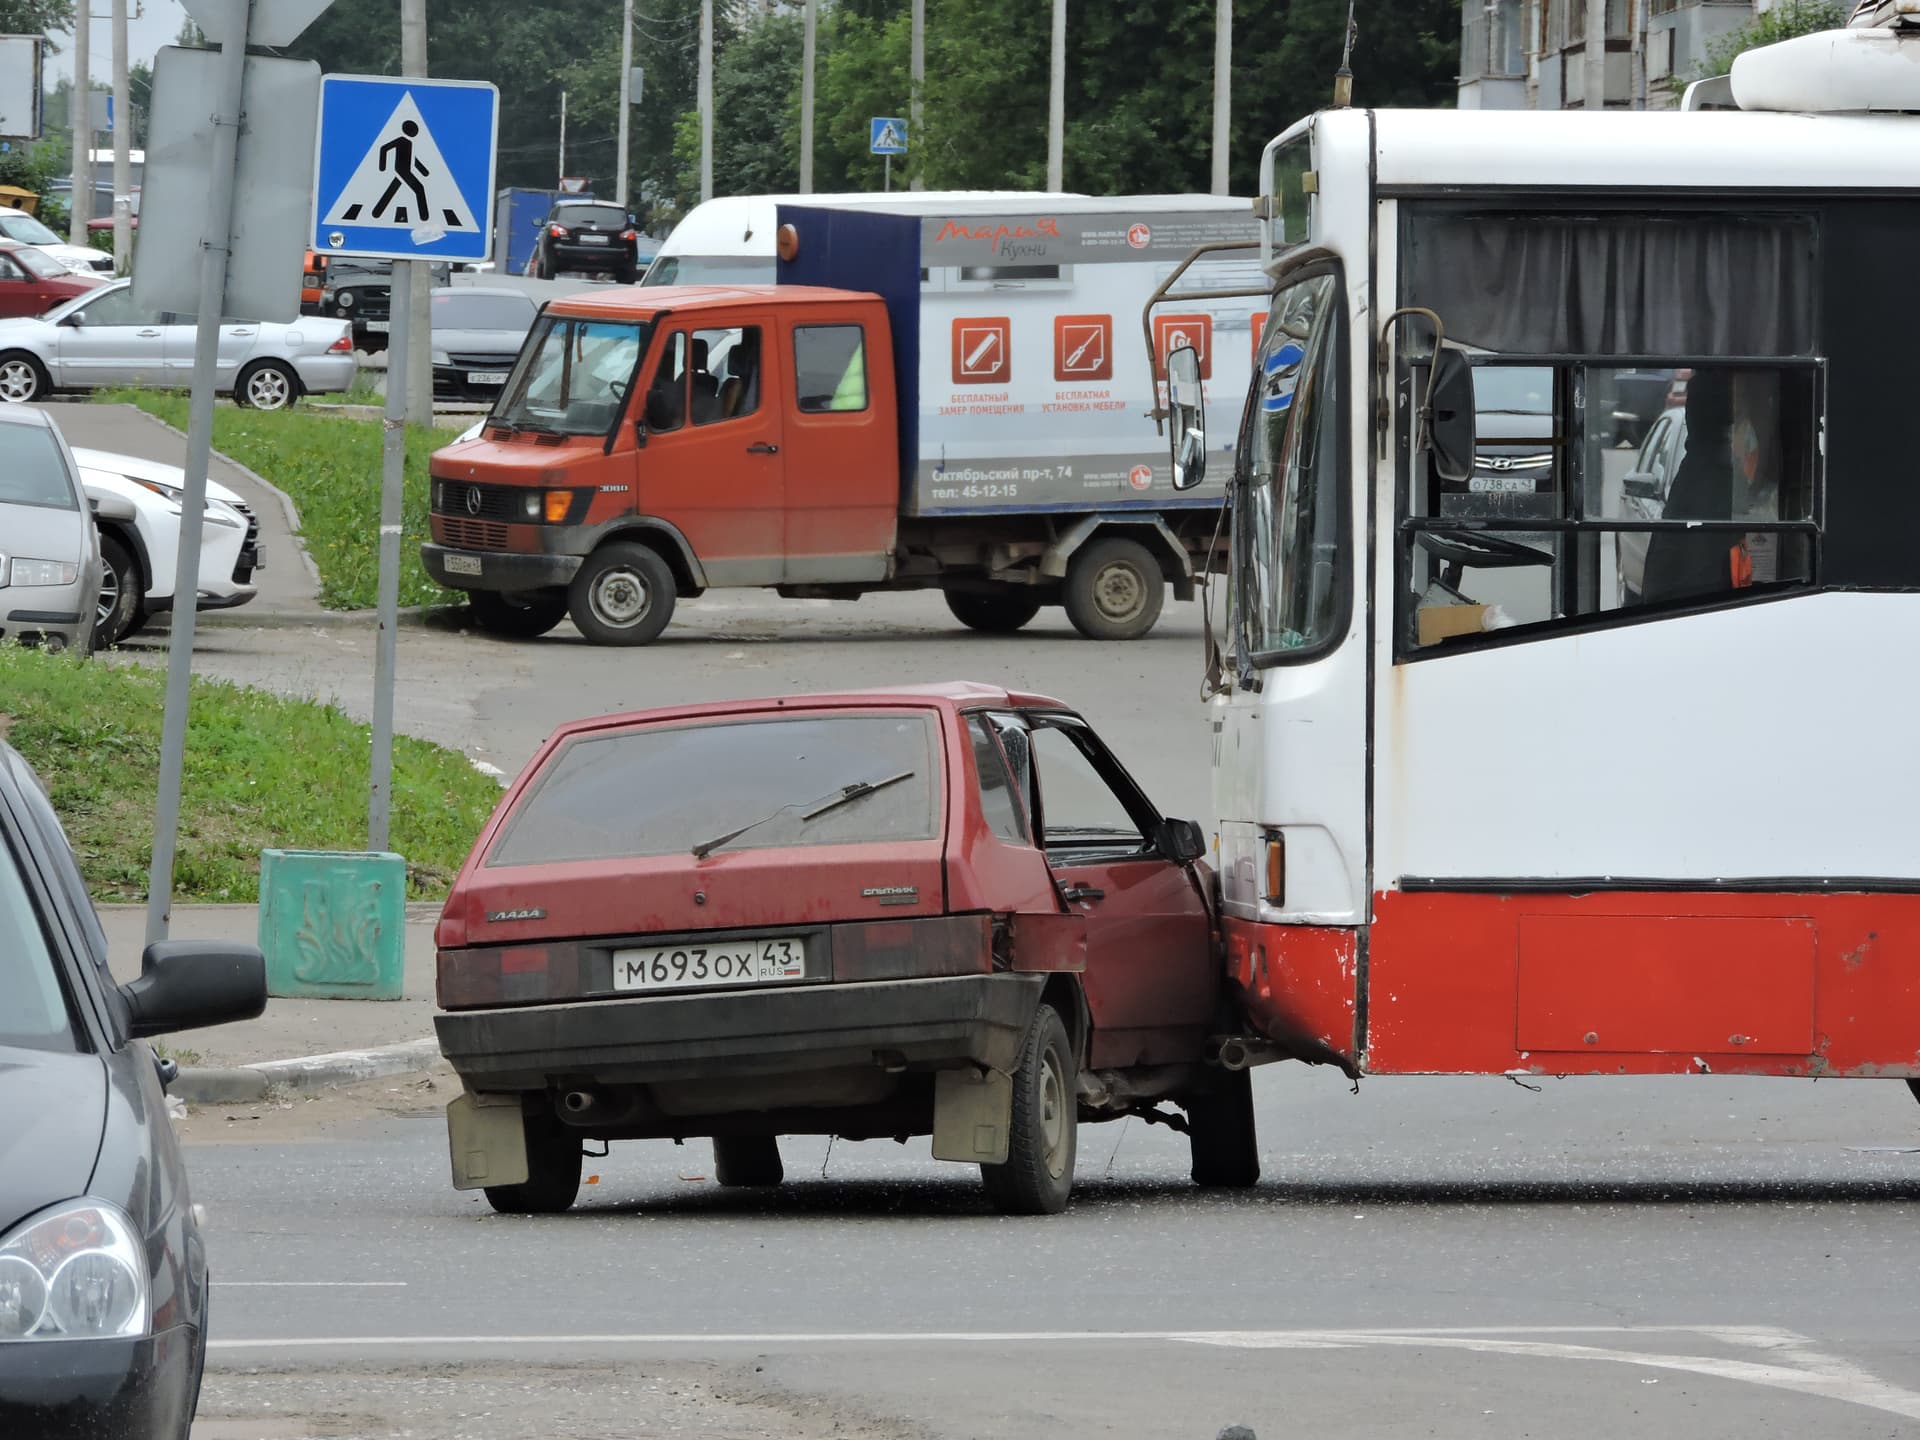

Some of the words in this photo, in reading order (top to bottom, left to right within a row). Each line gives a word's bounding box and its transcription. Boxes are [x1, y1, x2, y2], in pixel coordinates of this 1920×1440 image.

[1001, 241, 1047, 261] Кухни
[951, 392, 1009, 403] БЕСПЛАТНЫЙ
[1055, 390, 1110, 401] БЕСПЛАТНАЯ
[938, 406, 967, 416] ЗАМЕР
[969, 404, 1025, 416] ПОМЕЩЕНИЯ
[1042, 402, 1090, 413] УСТАНОВКА
[1093, 401, 1126, 411] МЕБЕЛИ
[932, 468, 1018, 482] Октябрьский
[1056, 466, 1073, 478] 74
[961, 484, 1017, 497] 45-12-15
[495, 909, 540, 921] ЛАДА
[762, 942, 792, 967] 43
[760, 967, 784, 977] RUS
